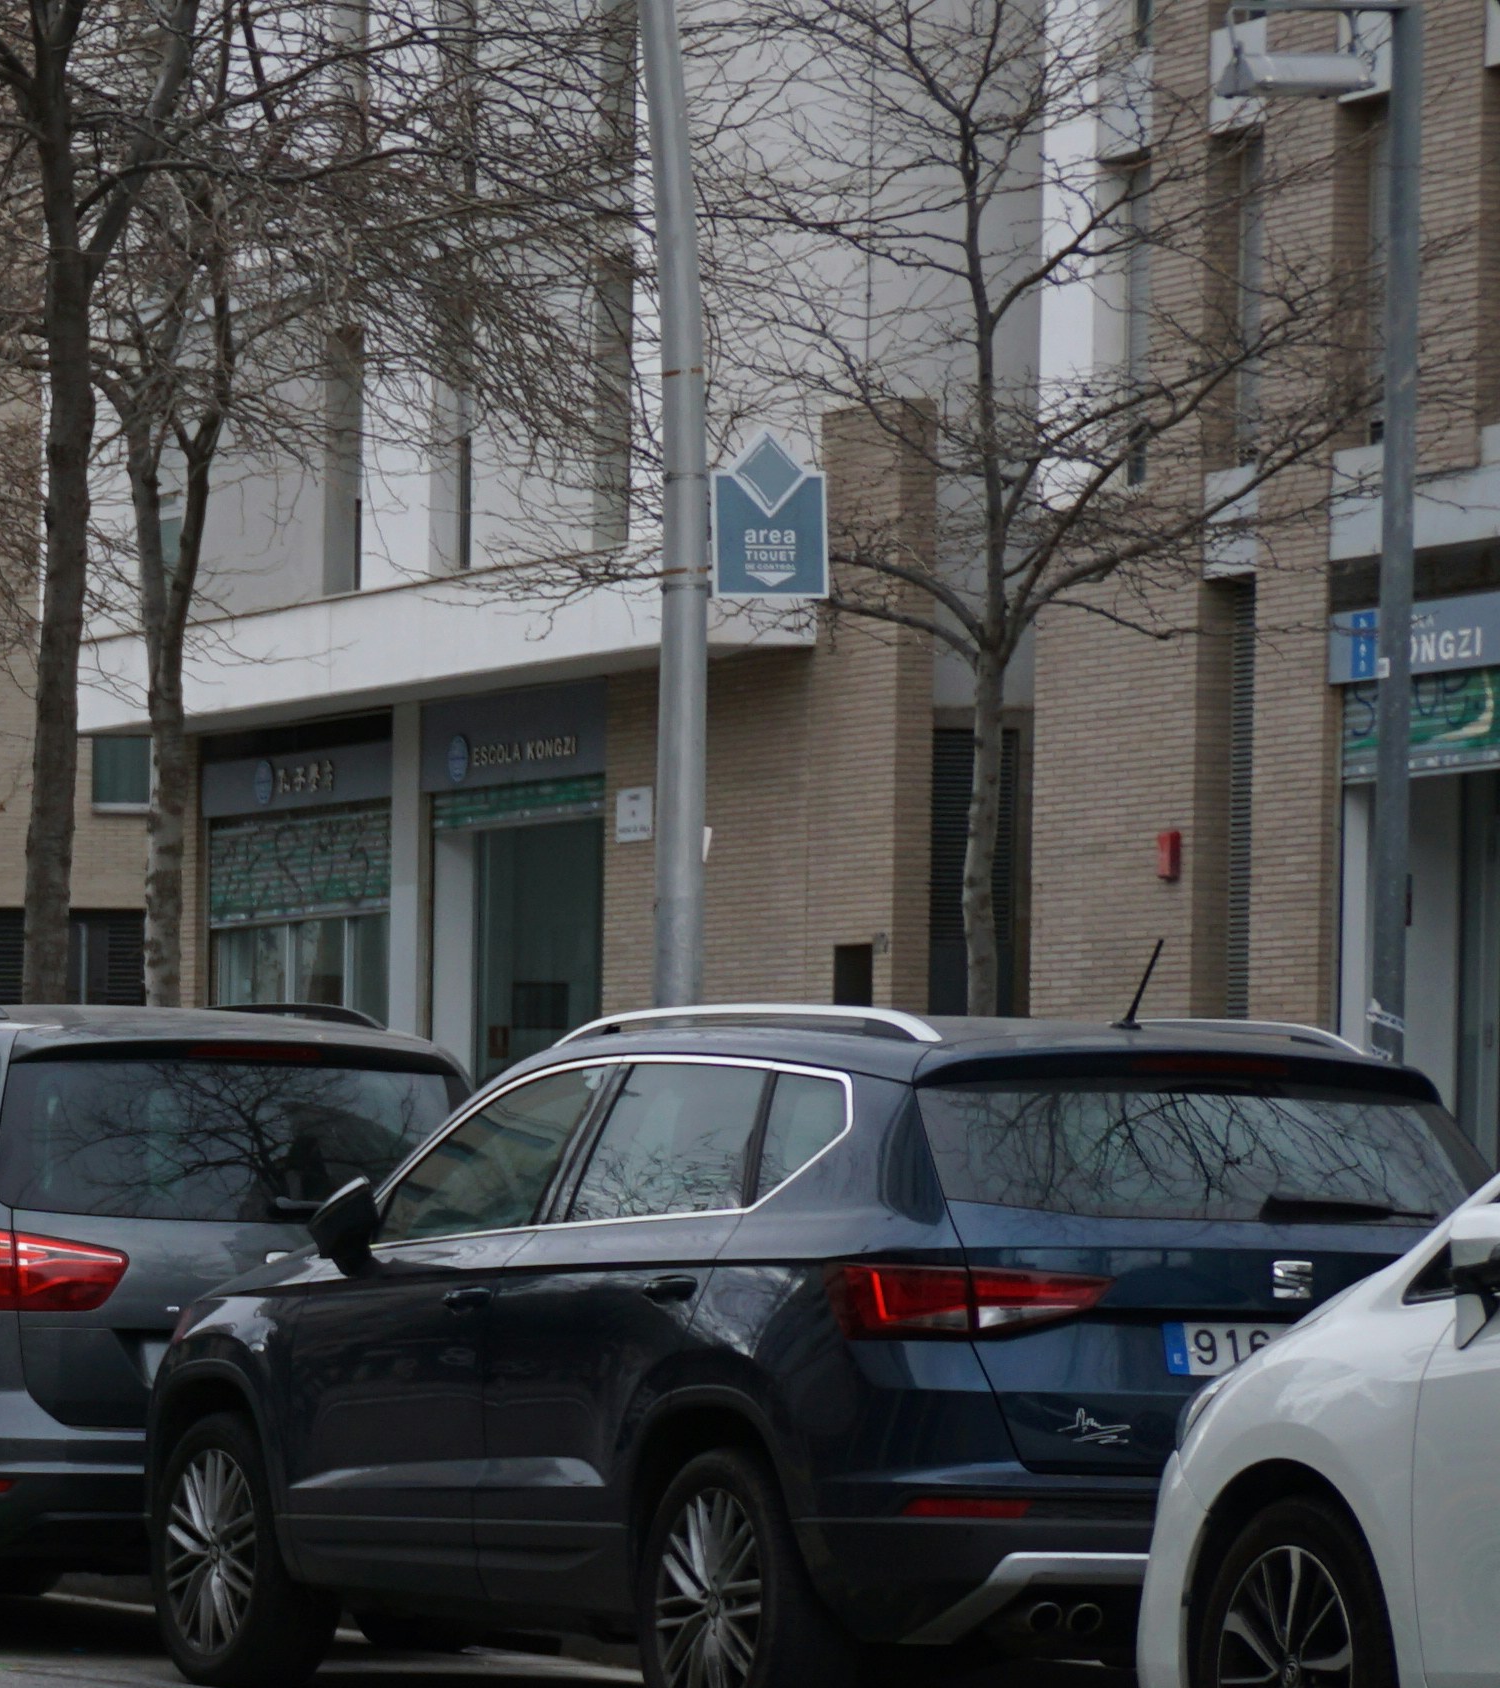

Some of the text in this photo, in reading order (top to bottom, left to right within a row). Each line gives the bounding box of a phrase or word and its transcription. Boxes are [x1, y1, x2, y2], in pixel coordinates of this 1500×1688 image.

[744, 529, 797, 544] area
[744, 550, 797, 562] TIQUET
[473, 735, 578, 767] ESCOLA KONGZI
